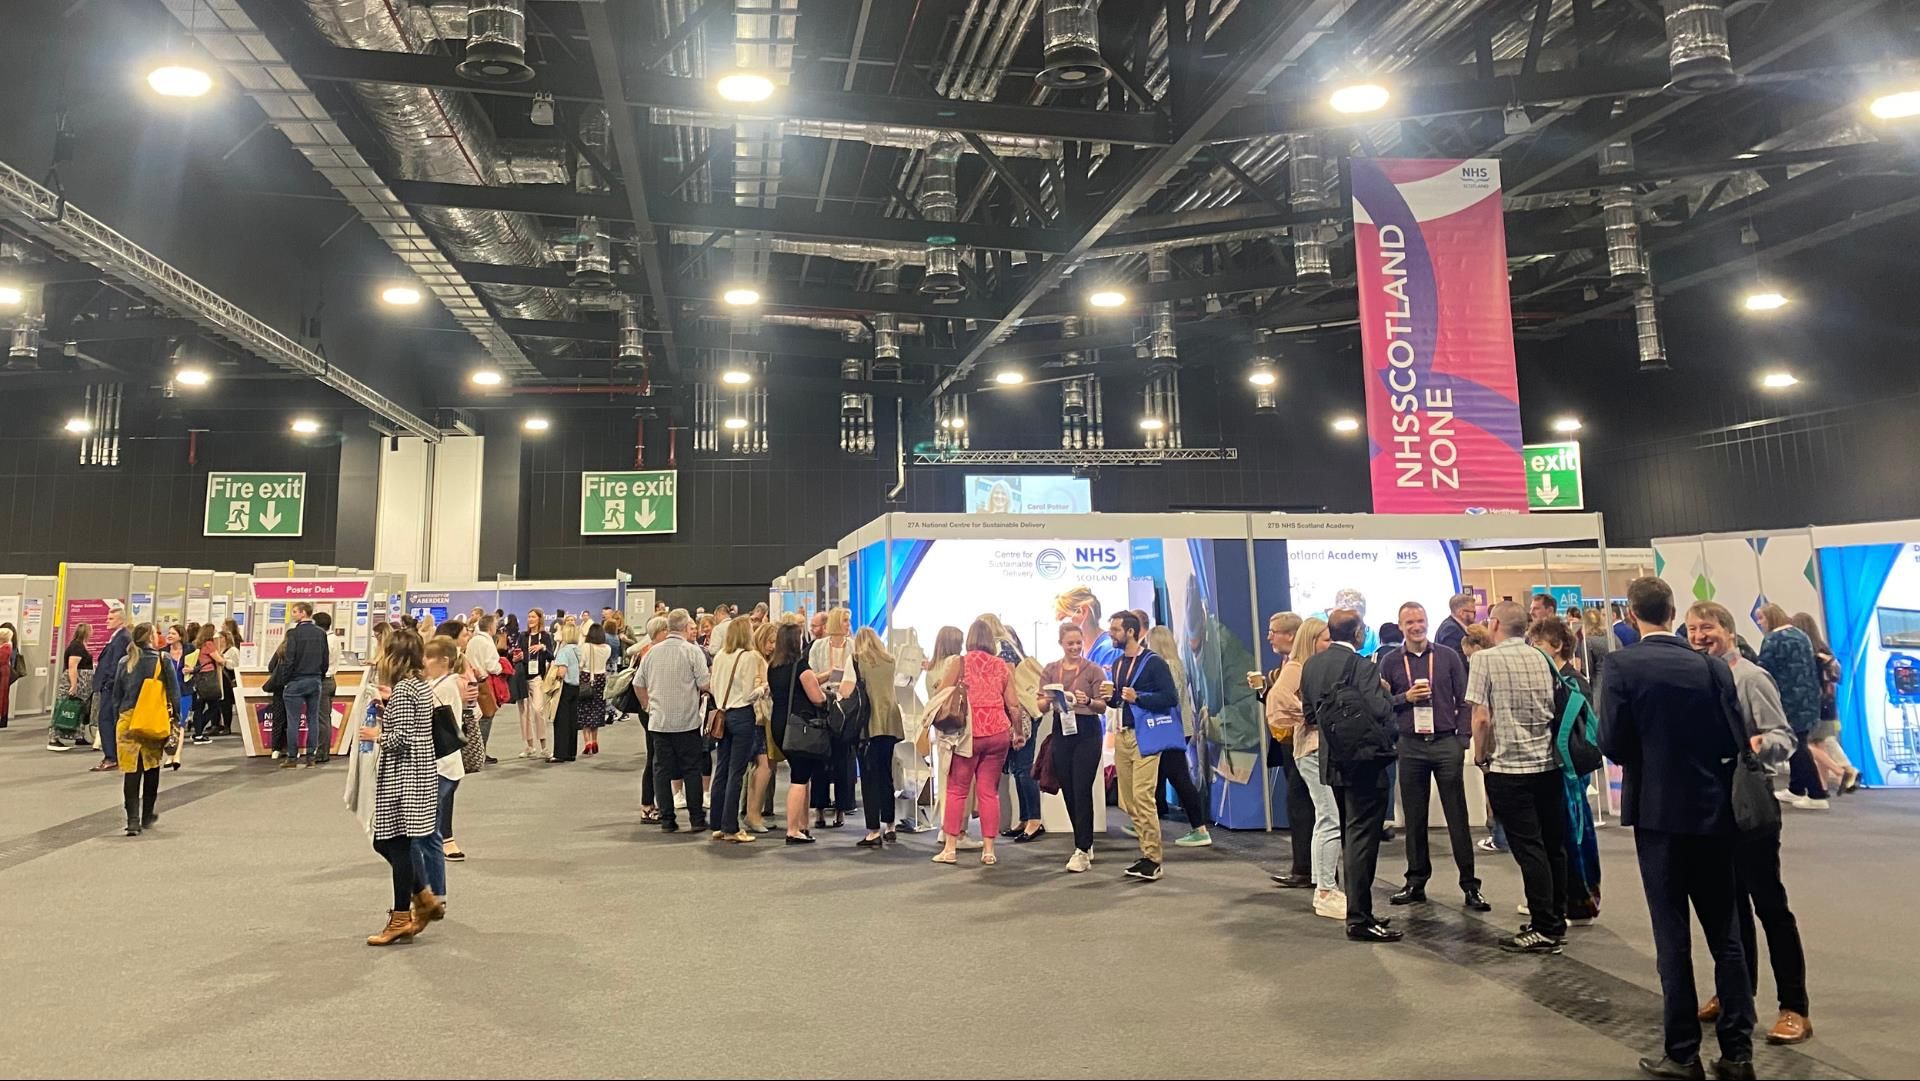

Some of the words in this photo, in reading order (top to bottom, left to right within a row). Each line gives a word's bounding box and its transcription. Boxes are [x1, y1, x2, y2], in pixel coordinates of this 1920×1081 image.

[1462, 167, 1488, 177] NHS
[1379, 224, 1424, 487] NHSSCOTLAND
[1426, 388, 1460, 489] ZONE
[1531, 448, 1577, 472] exit
[210, 477, 254, 499] Fire
[258, 478, 301, 499] exit
[585, 476, 628, 497] Fire
[632, 475, 673, 497] exit
[1020, 521, 1046, 529] Delivery
[1326, 522, 1355, 530] Academy
[994, 550, 1021, 559] Centre
[1022, 550, 1033, 559] for
[1076, 547, 1117, 562] NHS
[1327, 550, 1378, 562] Academy
[1397, 551, 1418, 560] NHS
[988, 560, 1033, 568] Sustainable
[1076, 574, 1118, 582] SCOTLAND
[286, 585, 312, 594] Poster
[314, 585, 335, 593] Desk
